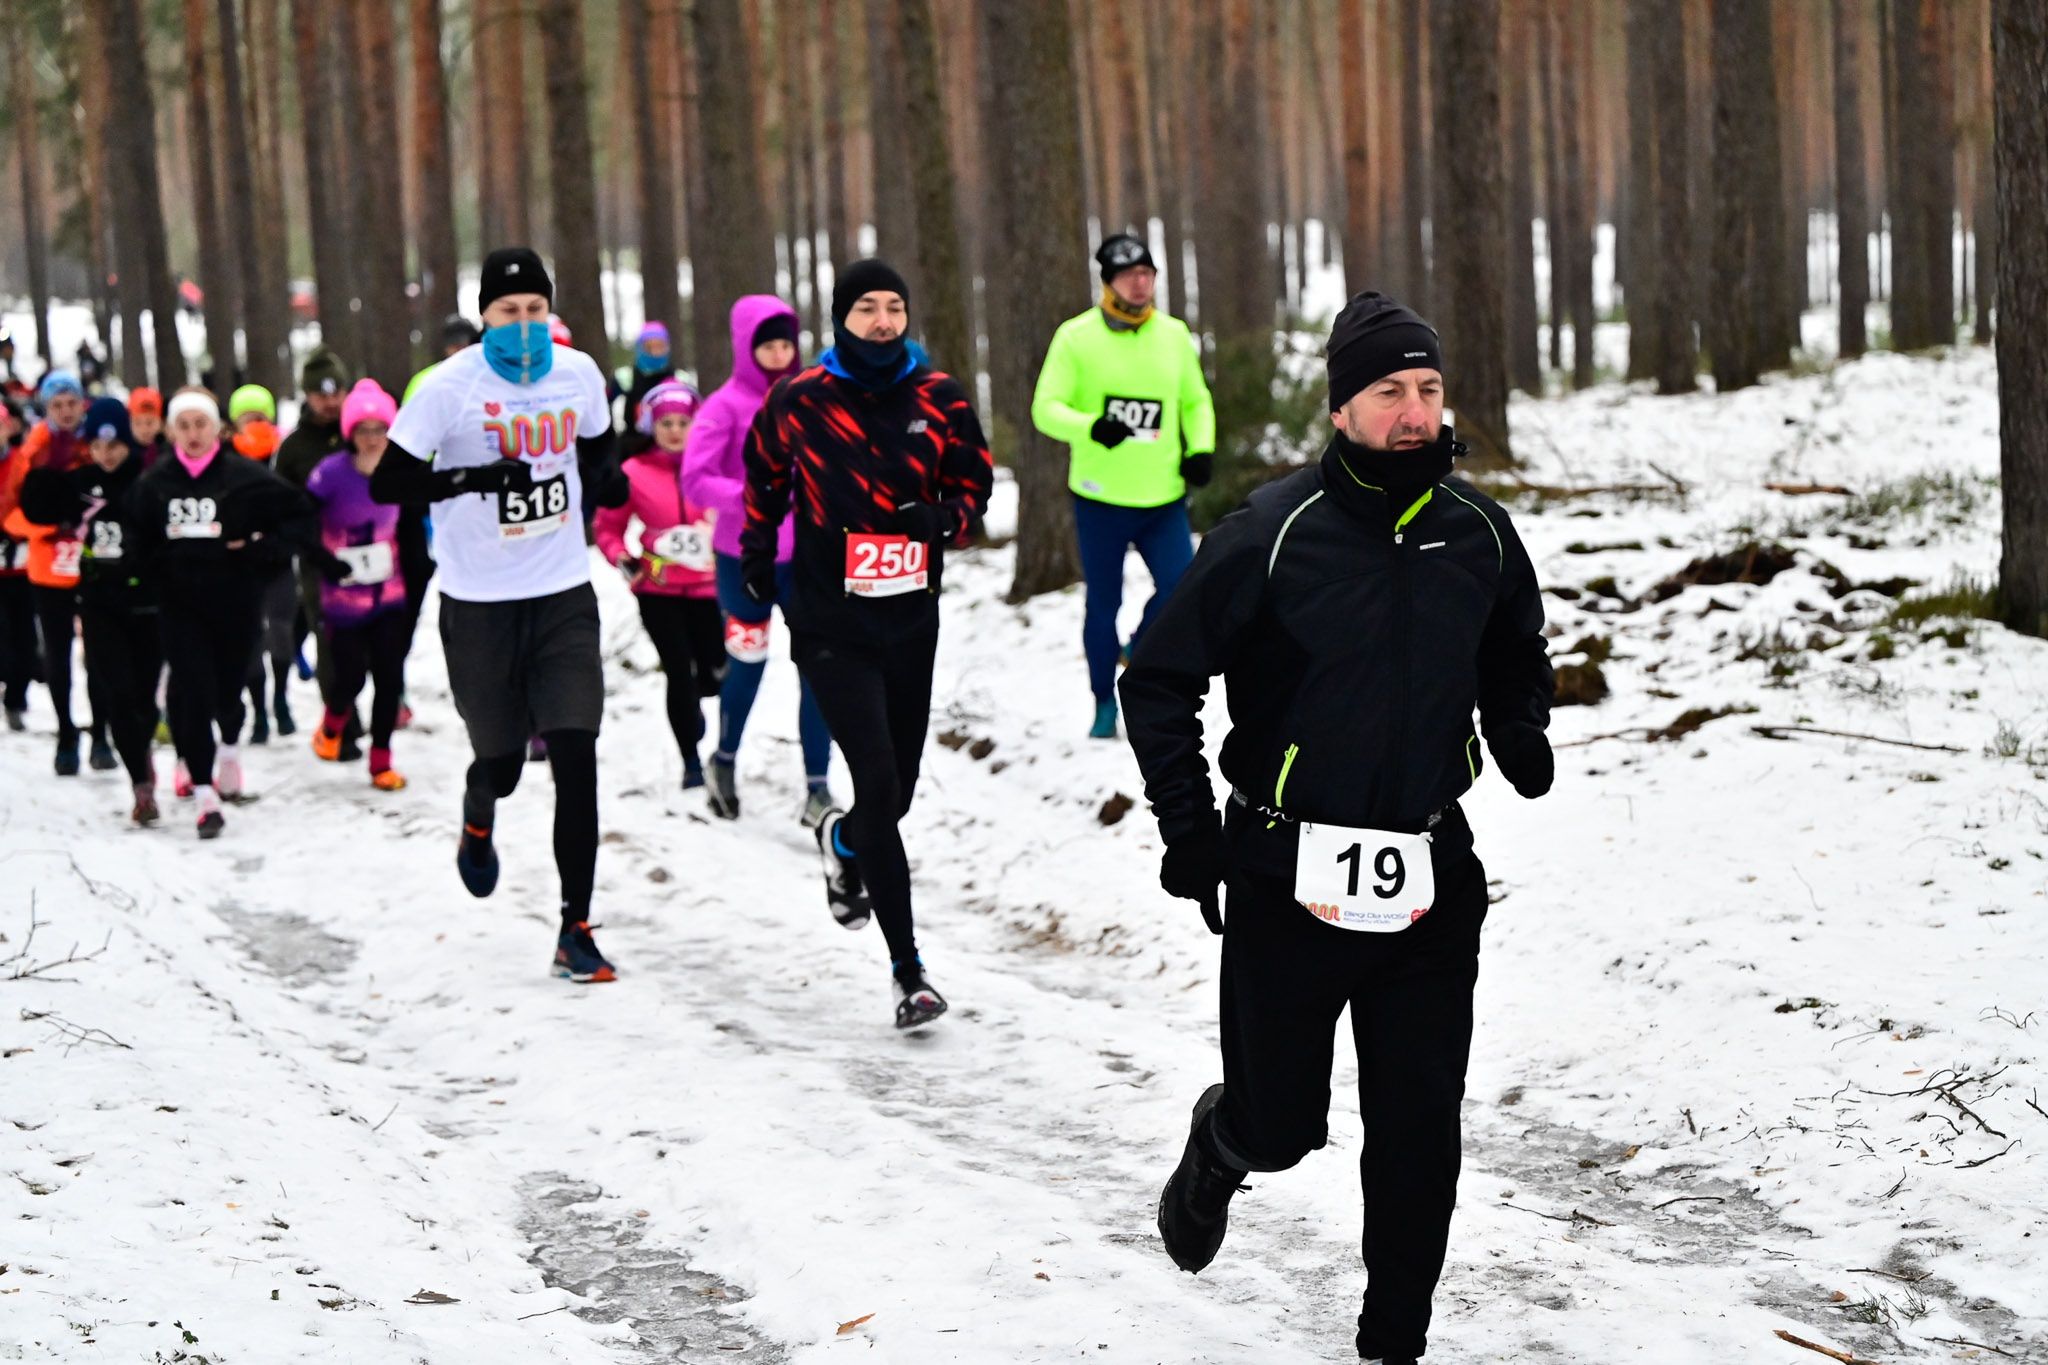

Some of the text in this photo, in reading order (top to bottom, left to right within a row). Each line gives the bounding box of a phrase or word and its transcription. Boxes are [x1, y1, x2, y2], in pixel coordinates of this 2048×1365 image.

[1107, 399, 1161, 428] 507
[168, 496, 217, 523] 539
[506, 481, 566, 522] 518
[853, 541, 923, 577] 250
[1336, 842, 1406, 899] 19
